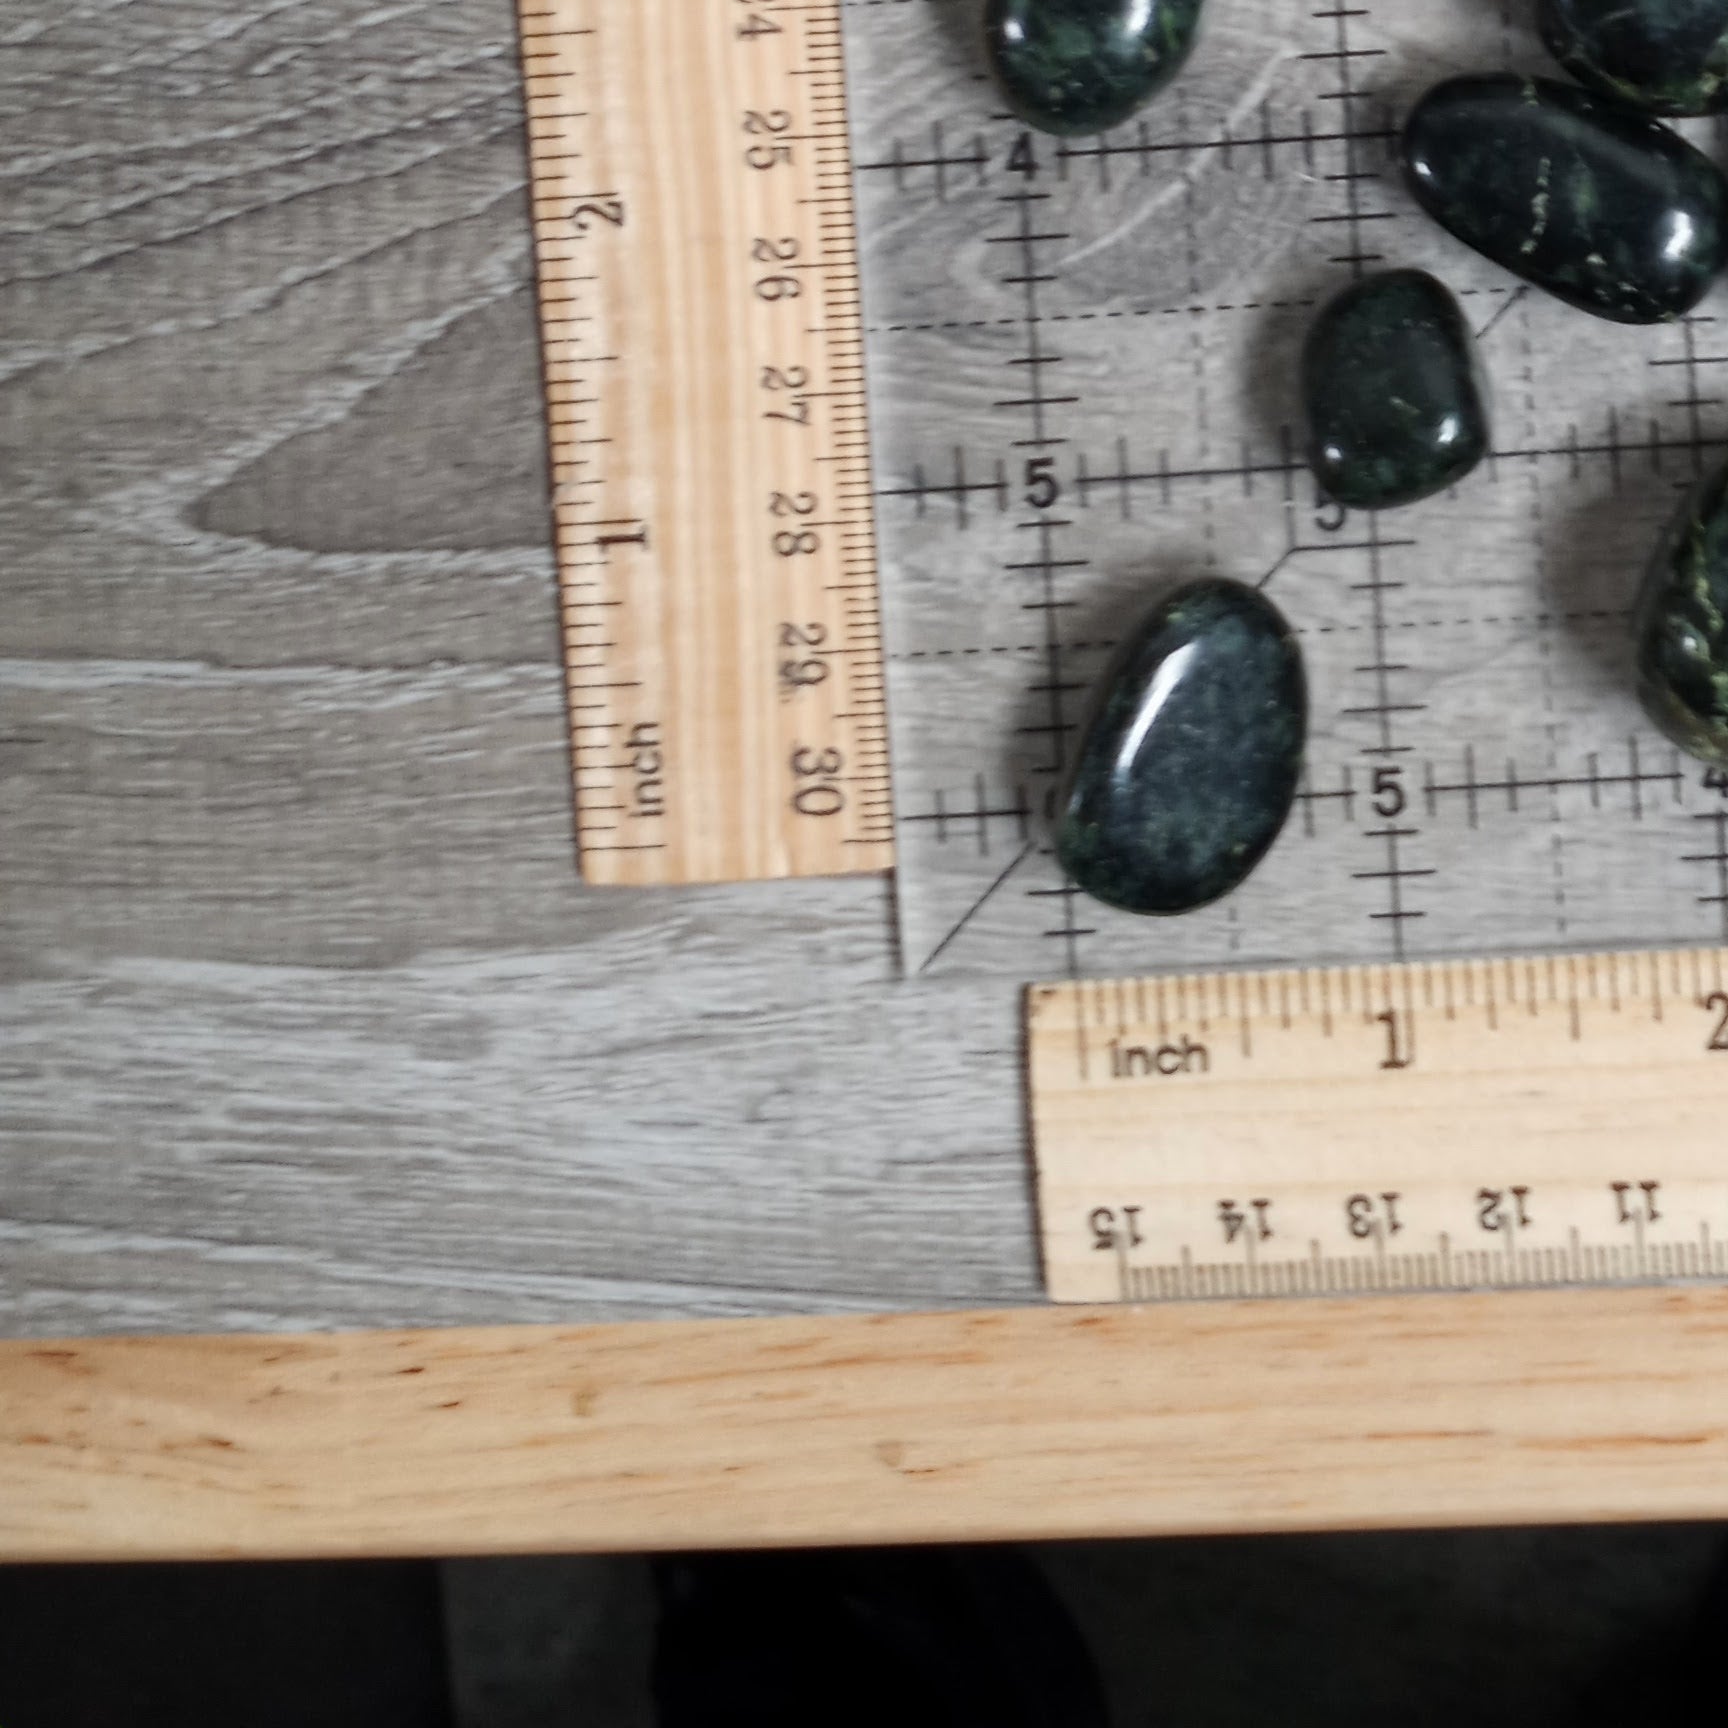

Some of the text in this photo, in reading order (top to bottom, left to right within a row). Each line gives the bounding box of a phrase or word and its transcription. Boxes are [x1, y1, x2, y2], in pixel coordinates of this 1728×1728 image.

[743, 109, 795, 170] 25
[1004, 129, 1039, 182] 4
[571, 200, 625, 231] 2
[752, 236, 803, 302] 26
[760, 364, 812, 428] 27
[1024, 456, 1059, 509] 5
[595, 523, 649, 552] 1
[769, 491, 820, 558] 28
[777, 621, 829, 690] 29
[624, 720, 665, 818] inch
[790, 744, 845, 817] 30
[1371, 766, 1406, 818] 5
[1107, 1034, 1211, 1078] inch
[1377, 1010, 1409, 1069] 1
[1088, 1206, 1143, 1251] 15
[1216, 1198, 1274, 1244] 14
[1344, 1192, 1404, 1239] 13
[1476, 1185, 1532, 1232] 12
[1610, 1180, 1661, 1224] 11
